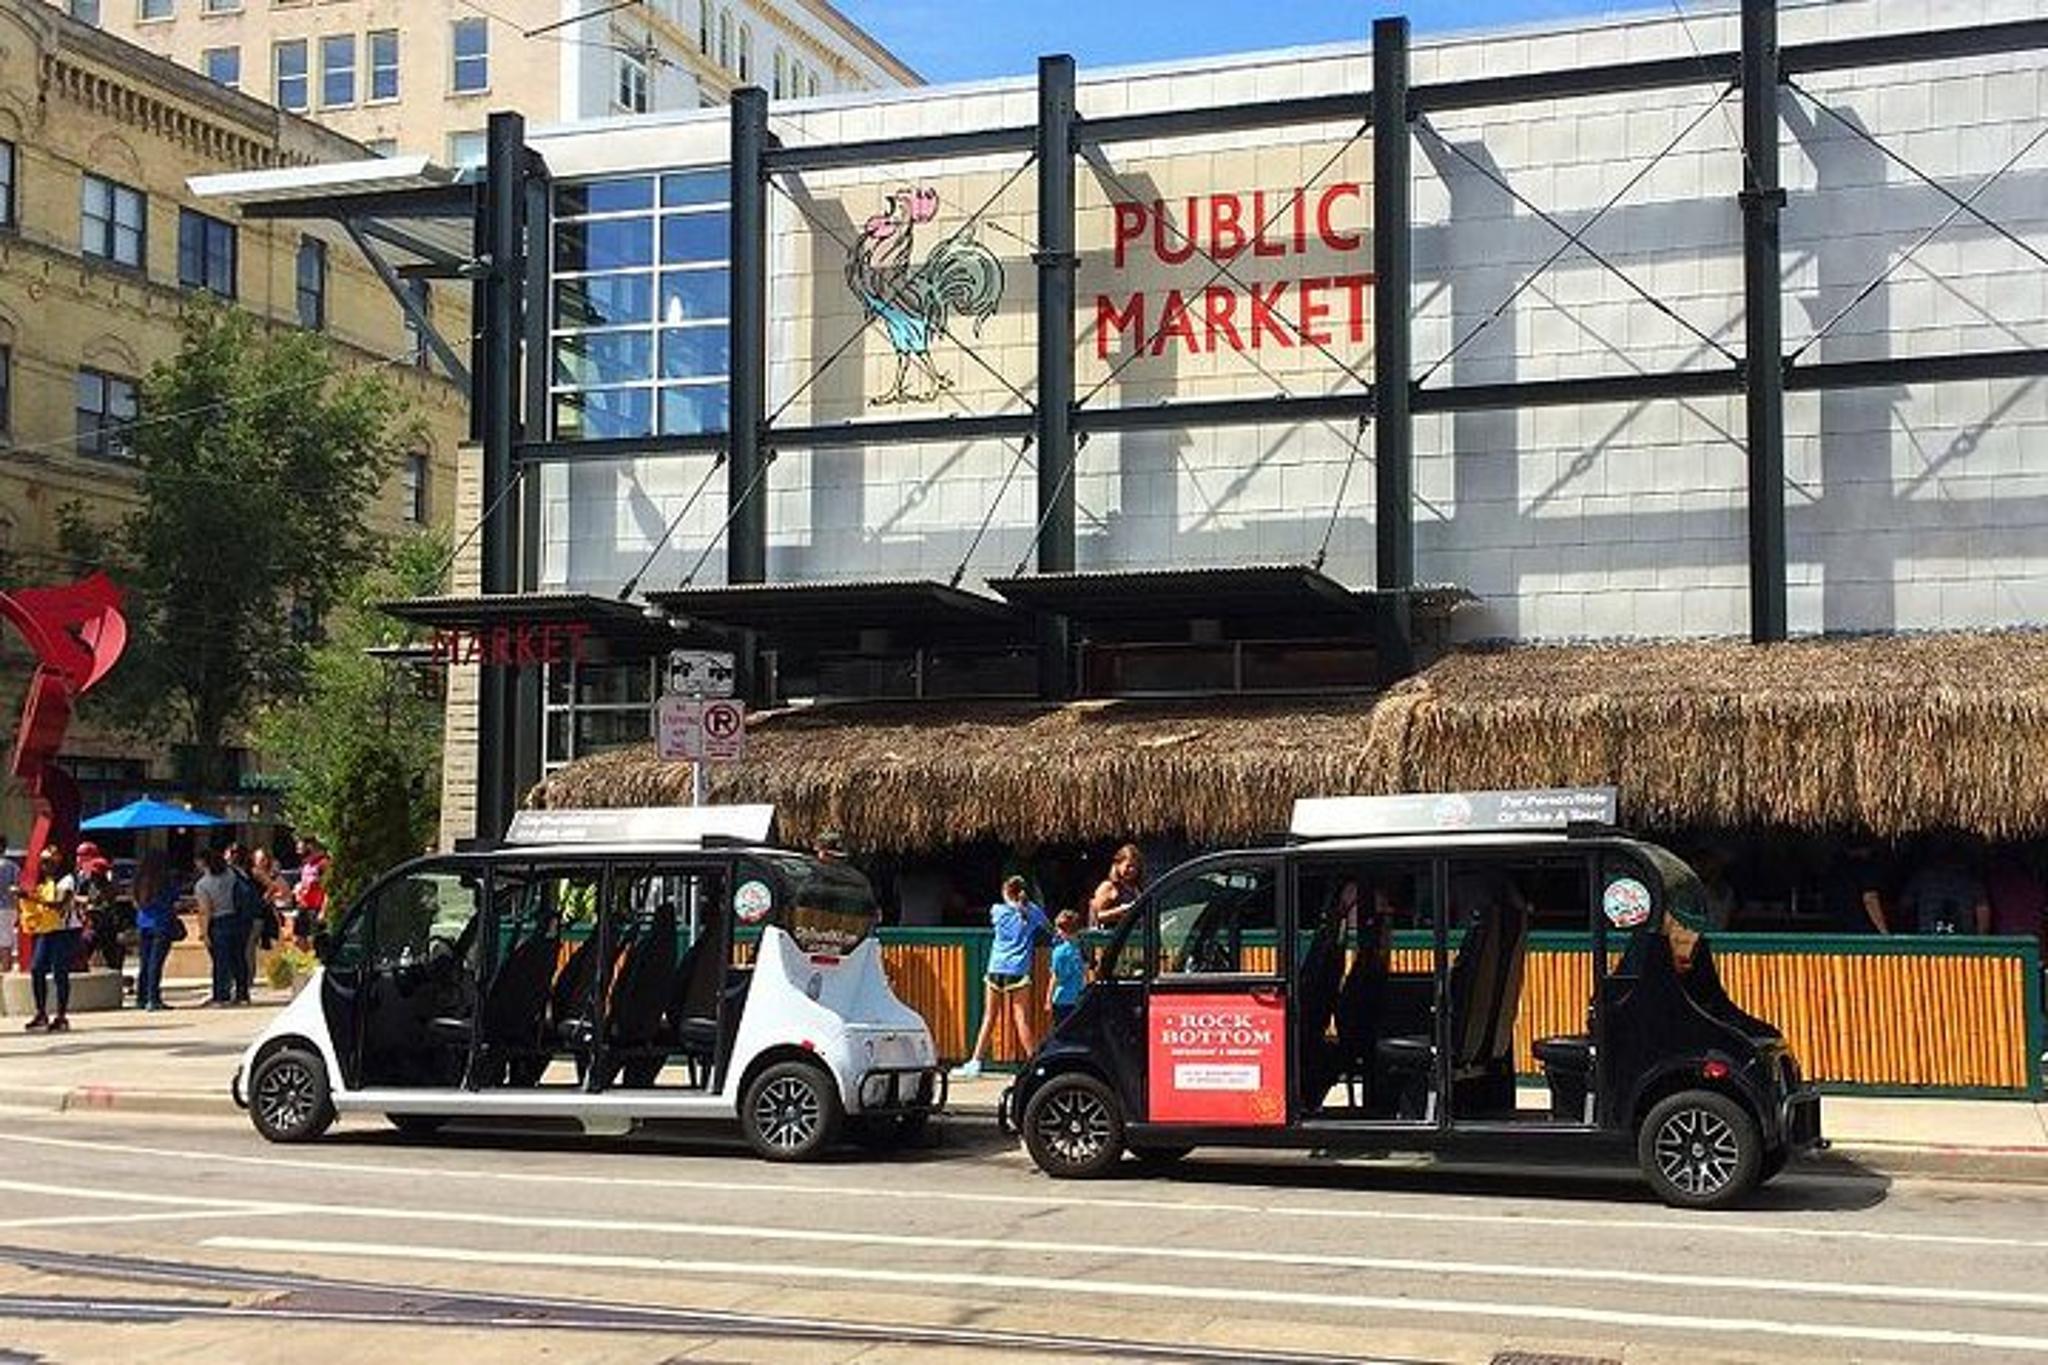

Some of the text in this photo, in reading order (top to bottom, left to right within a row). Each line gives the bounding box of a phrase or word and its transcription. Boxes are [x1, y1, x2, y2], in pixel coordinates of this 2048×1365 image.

[1114, 182, 1361, 269] PUBLIC
[1097, 273, 1379, 361] MARKET
[432, 621, 592, 666] MARKET
[1161, 1029, 1272, 1045] BOTTOM
[1180, 1013, 1253, 1028] ROCK
